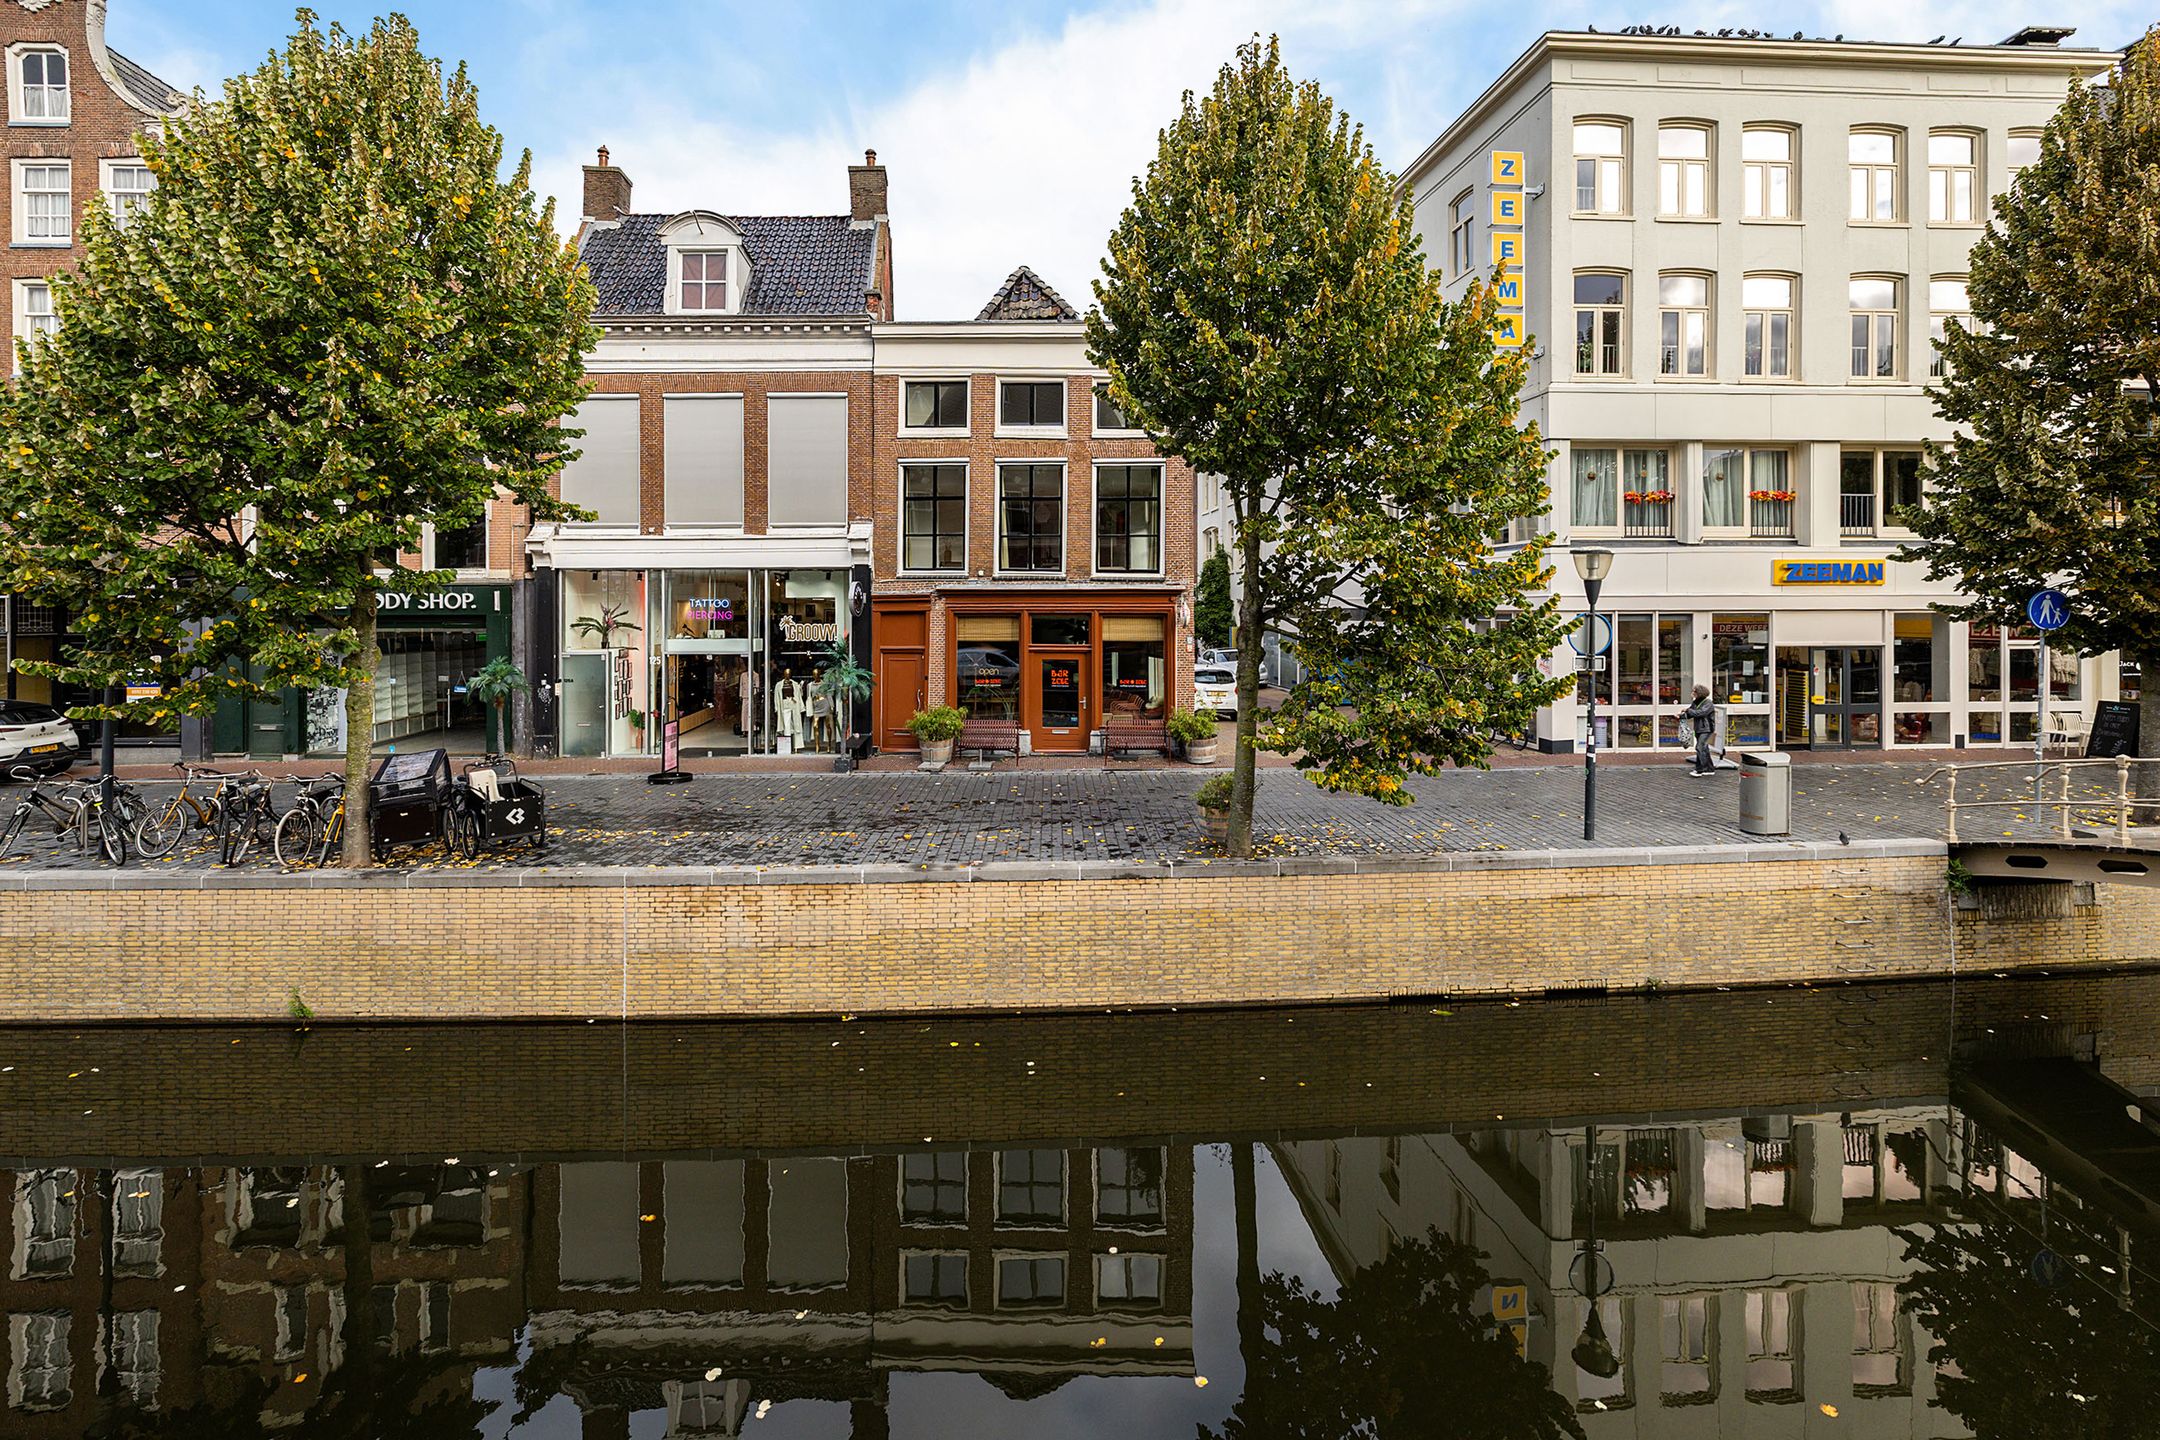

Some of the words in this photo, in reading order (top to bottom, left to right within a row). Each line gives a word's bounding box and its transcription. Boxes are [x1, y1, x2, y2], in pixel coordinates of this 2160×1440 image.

[1498, 159, 1518, 339] ZEEMA
[1786, 563, 1884, 581] ZEEMAN
[375, 592, 412, 609] ODY
[689, 598, 730, 608] TATTOO
[686, 610, 733, 620] PIERCING
[785, 623, 839, 642] GROOVY!
[1719, 624, 1743, 633] DEZE
[649, 656, 661, 665] 125
[978, 667, 999, 676] open
